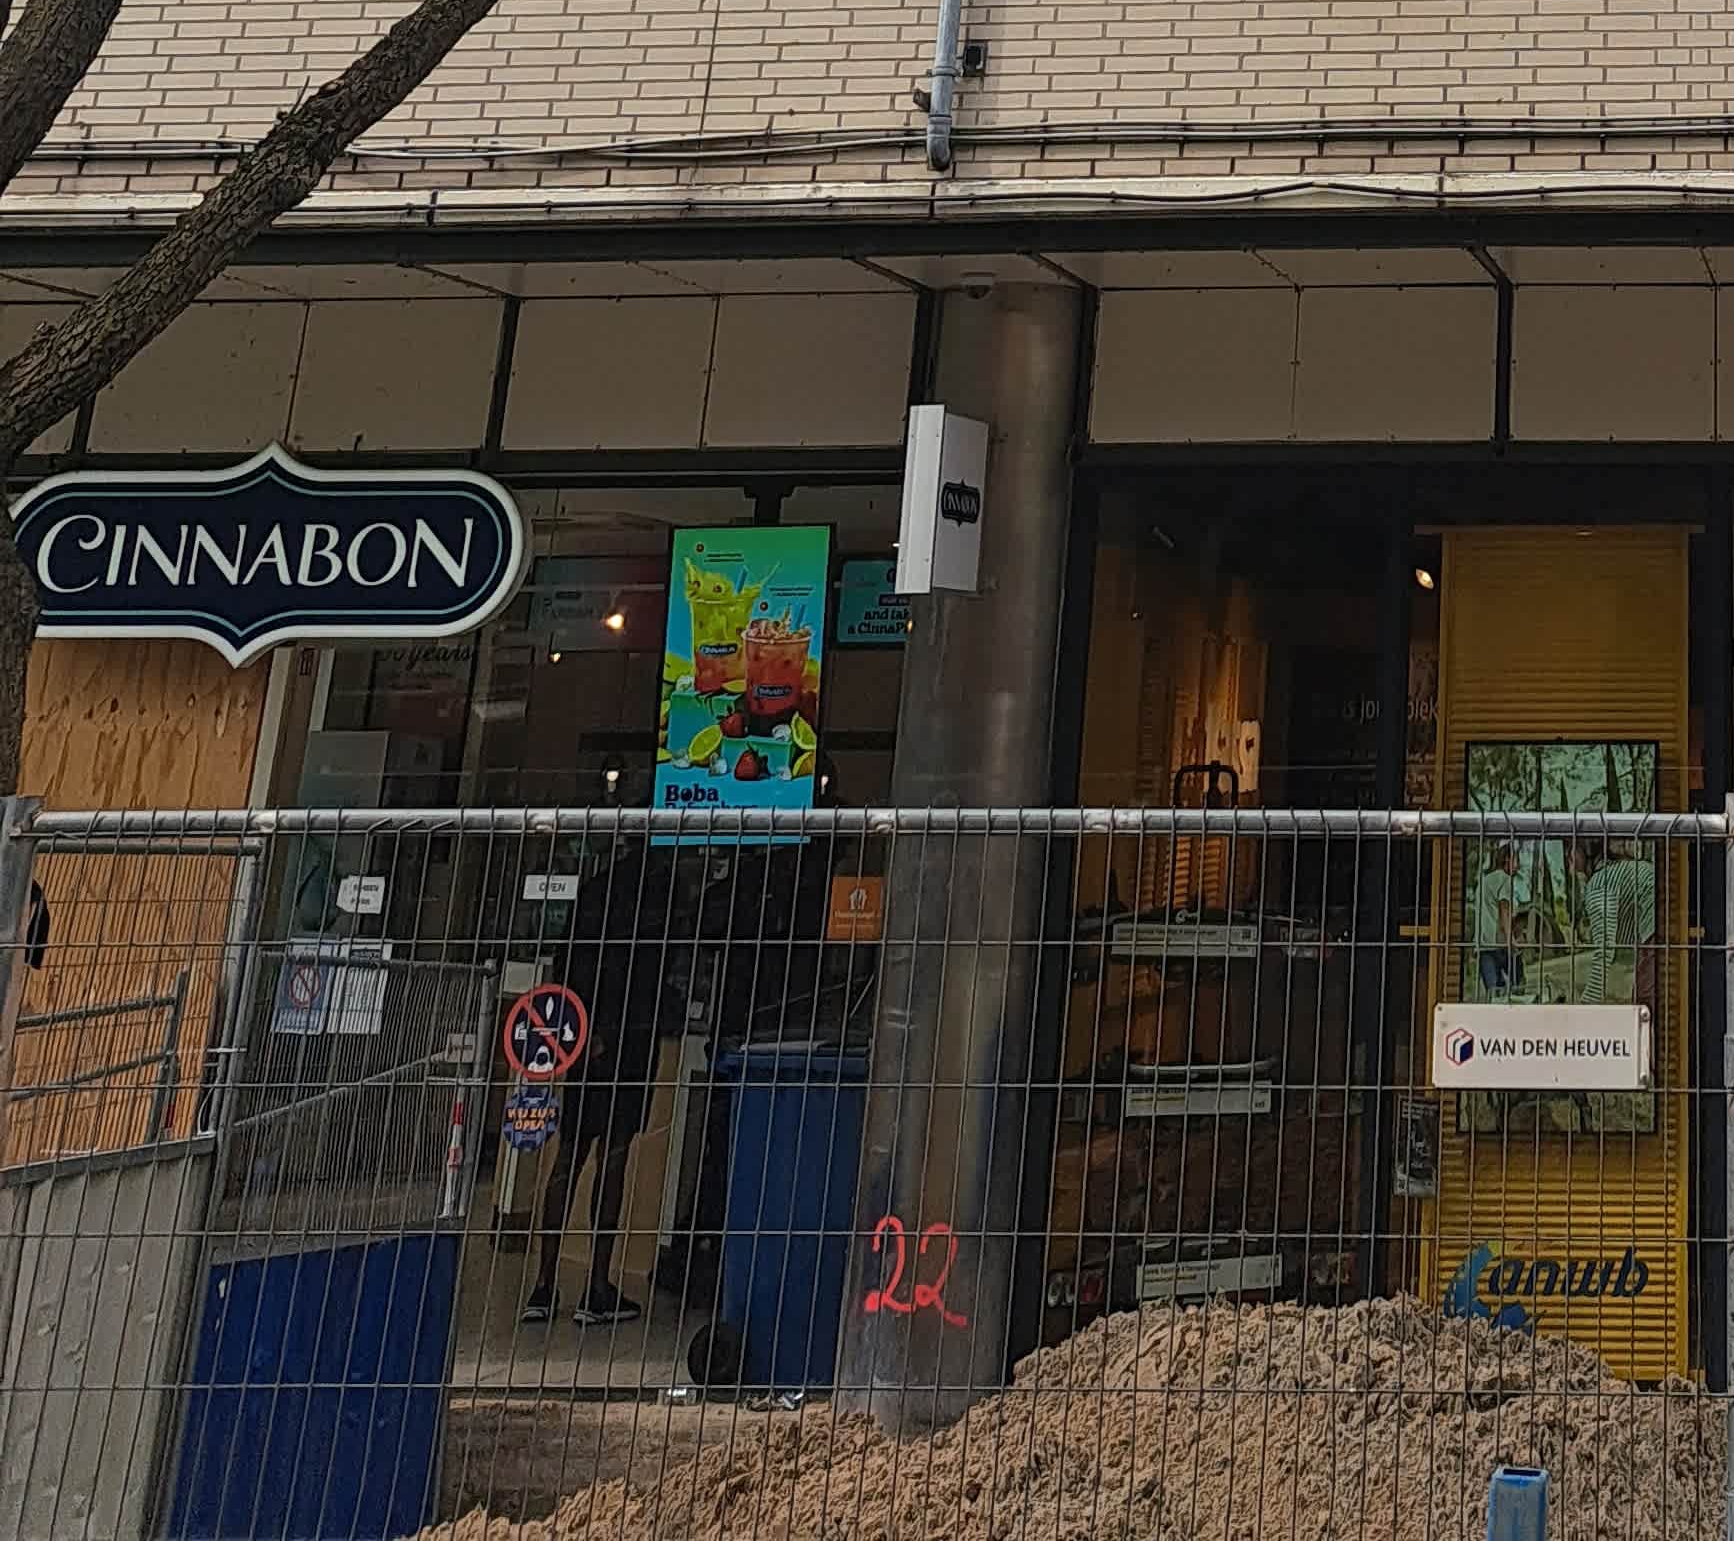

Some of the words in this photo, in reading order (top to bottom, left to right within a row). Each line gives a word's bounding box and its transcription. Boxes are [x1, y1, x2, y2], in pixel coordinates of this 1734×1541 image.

[36, 514, 473, 594] CINNABON
[665, 783, 719, 803] Boba
[1480, 1038, 1516, 1057] VAN
[1522, 1038, 1558, 1057] DEN
[1564, 1038, 1631, 1057] HEUVEL
[864, 1216, 967, 1327] 22
[1489, 1245, 1649, 1297] anwb
